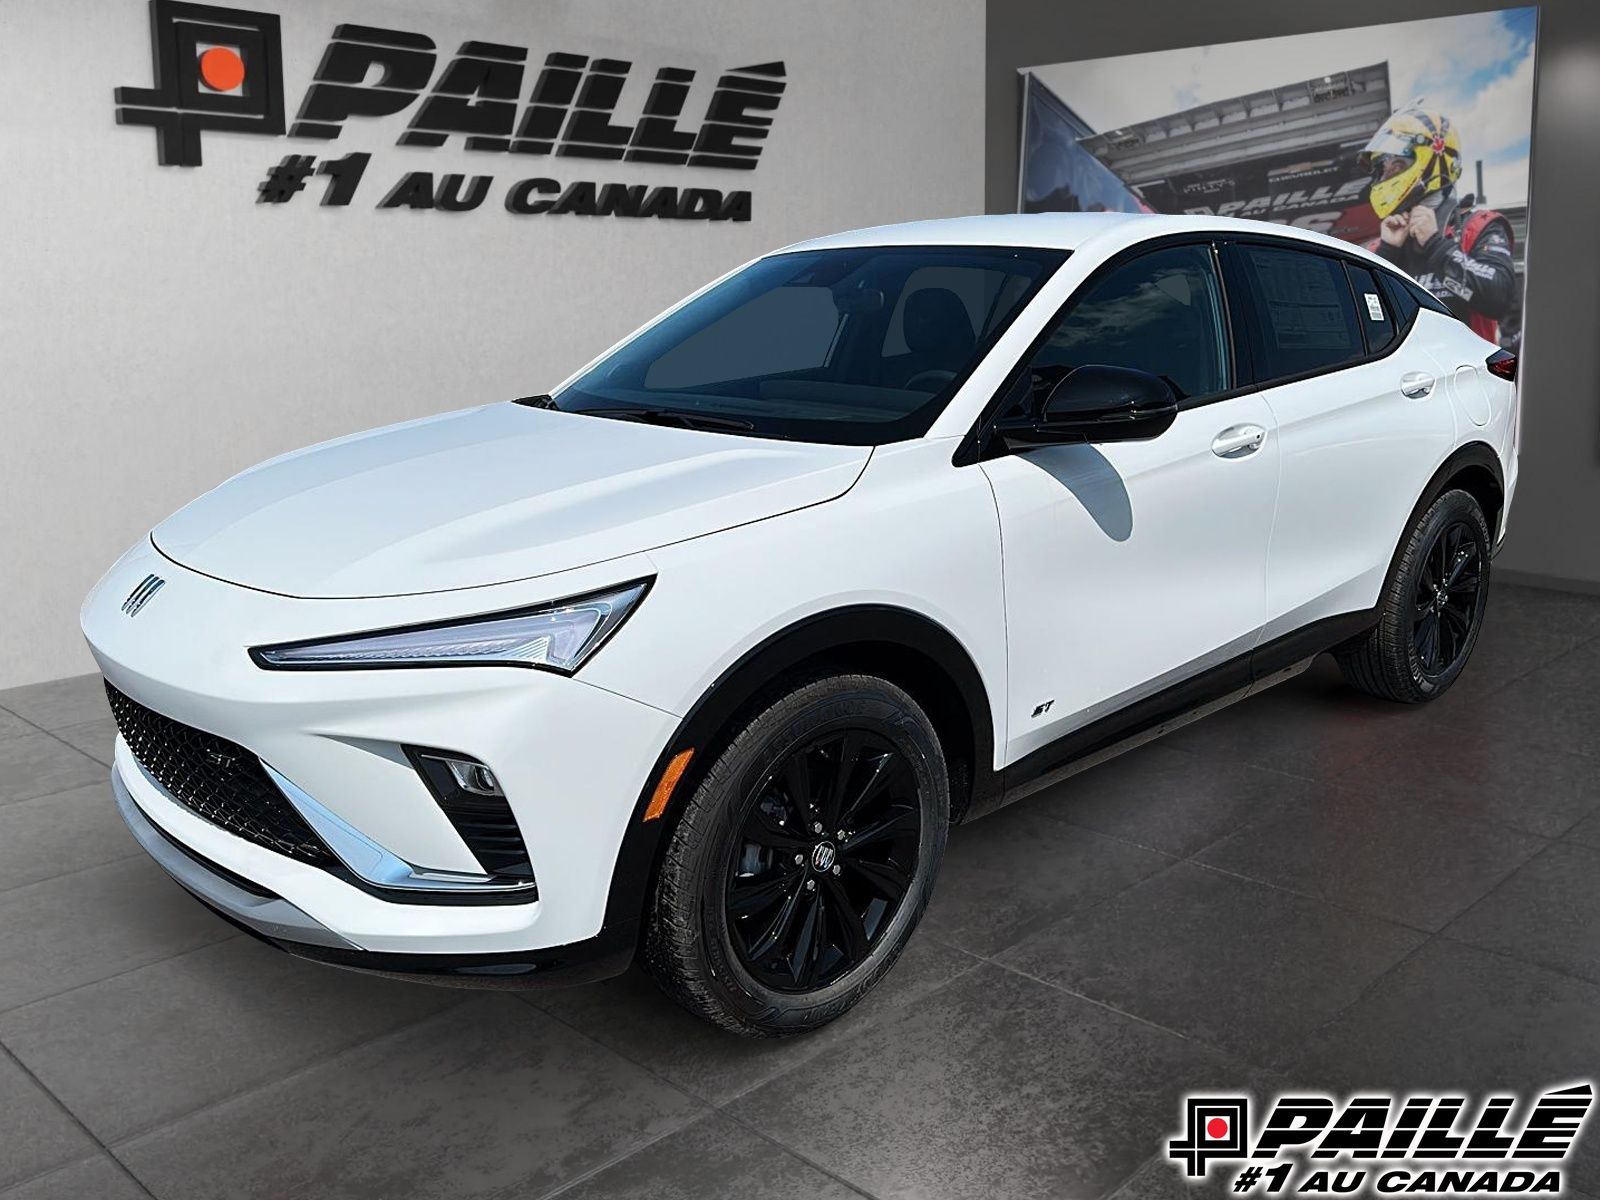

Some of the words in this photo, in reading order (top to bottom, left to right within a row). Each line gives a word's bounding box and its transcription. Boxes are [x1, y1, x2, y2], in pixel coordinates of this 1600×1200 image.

[286, 23, 788, 170] PAILLÉ
[256, 152, 372, 206] #1
[375, 171, 494, 212] AU
[504, 177, 753, 222] CANADA
